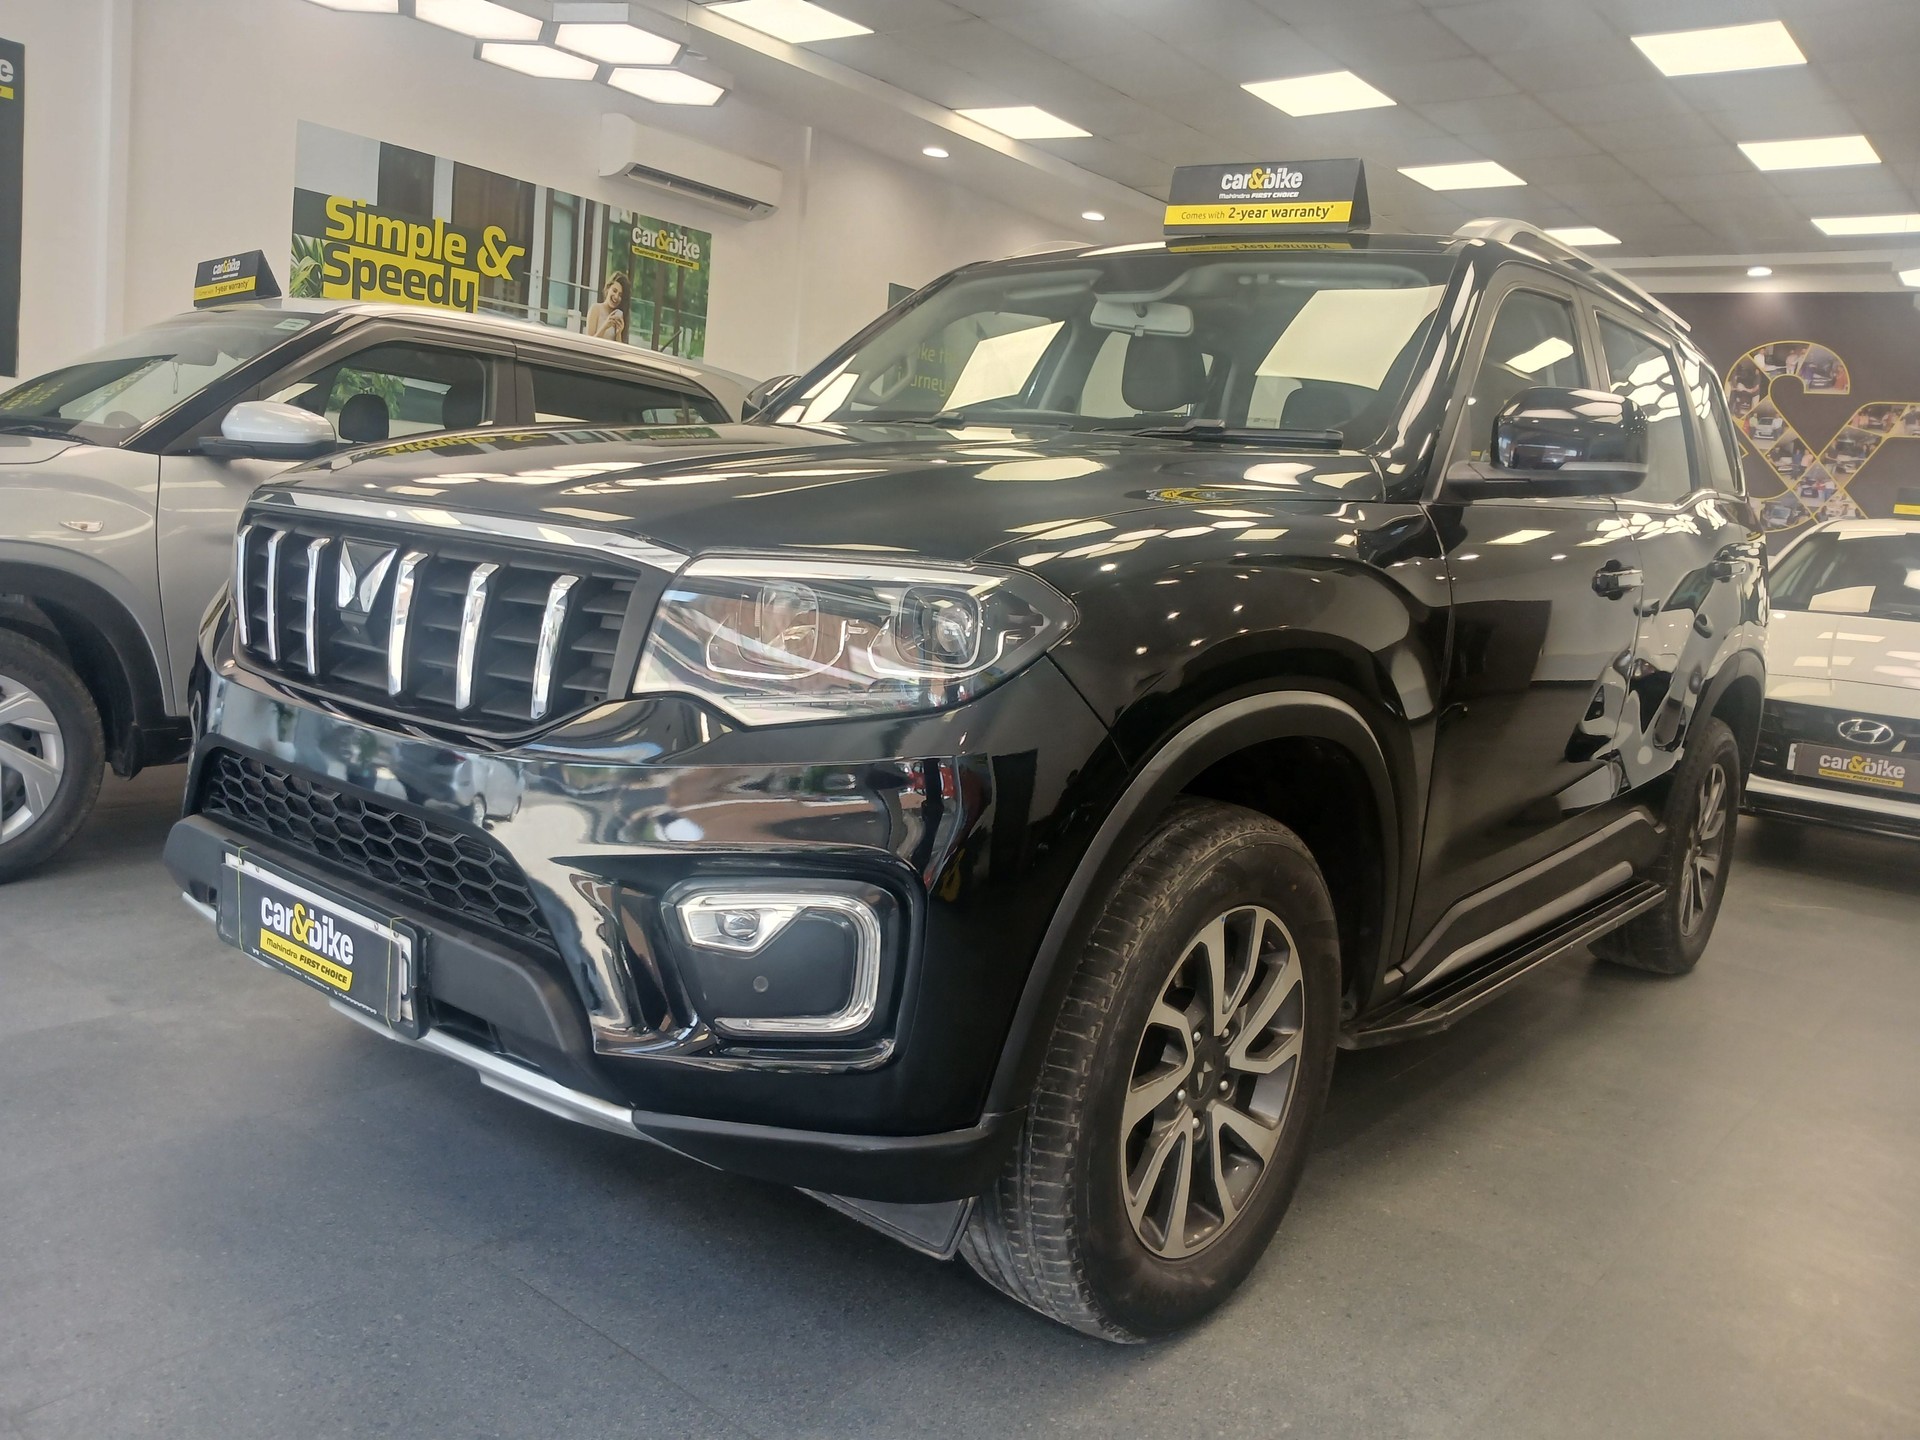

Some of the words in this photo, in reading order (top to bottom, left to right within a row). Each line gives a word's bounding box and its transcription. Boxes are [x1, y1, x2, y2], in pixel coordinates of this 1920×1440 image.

[1221, 167, 1303, 190] car&bike
[1272, 191, 1300, 199] CHOICE
[325, 195, 467, 266] Simple
[1181, 211, 1206, 220] Comes
[1207, 211, 1225, 220] with
[1228, 207, 1268, 221] 2-year
[631, 227, 700, 260] car&bike
[323, 242, 475, 314] Speedy
[1819, 754, 1906, 779] car&bike
[261, 897, 354, 965] car&bike
[266, 937, 298, 959] Mahindra
[299, 954, 321, 971] FIRST
[320, 965, 348, 984] CHOICE
